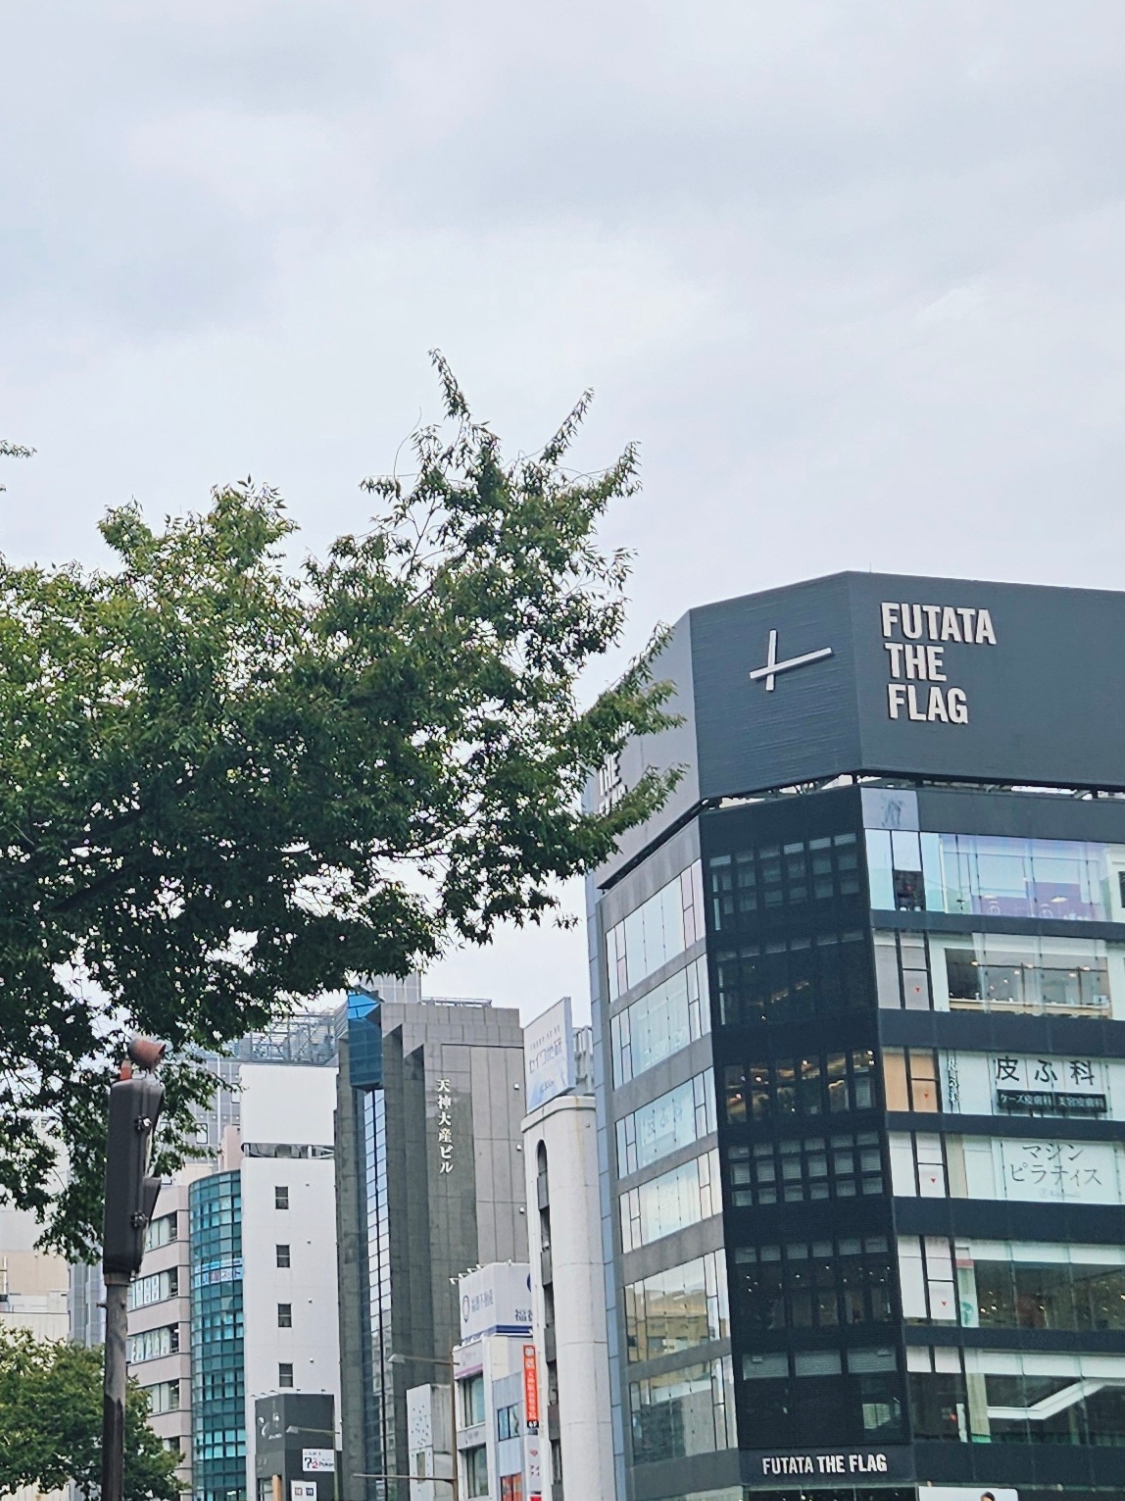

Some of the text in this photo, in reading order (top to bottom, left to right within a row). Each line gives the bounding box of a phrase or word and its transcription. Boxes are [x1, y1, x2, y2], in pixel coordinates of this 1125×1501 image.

[880, 601, 997, 645] FUTATA
[884, 642, 947, 681] THE
[888, 683, 968, 724] FLAG
[996, 1055, 1095, 1085] 皮ふ科
[437, 1079, 454, 1173] 天神大産ビル
[1022, 1143, 1083, 1161] マシン
[1010, 1162, 1102, 1188] ピラティス
[762, 1453, 887, 1475] FUTATA THE FLAG
